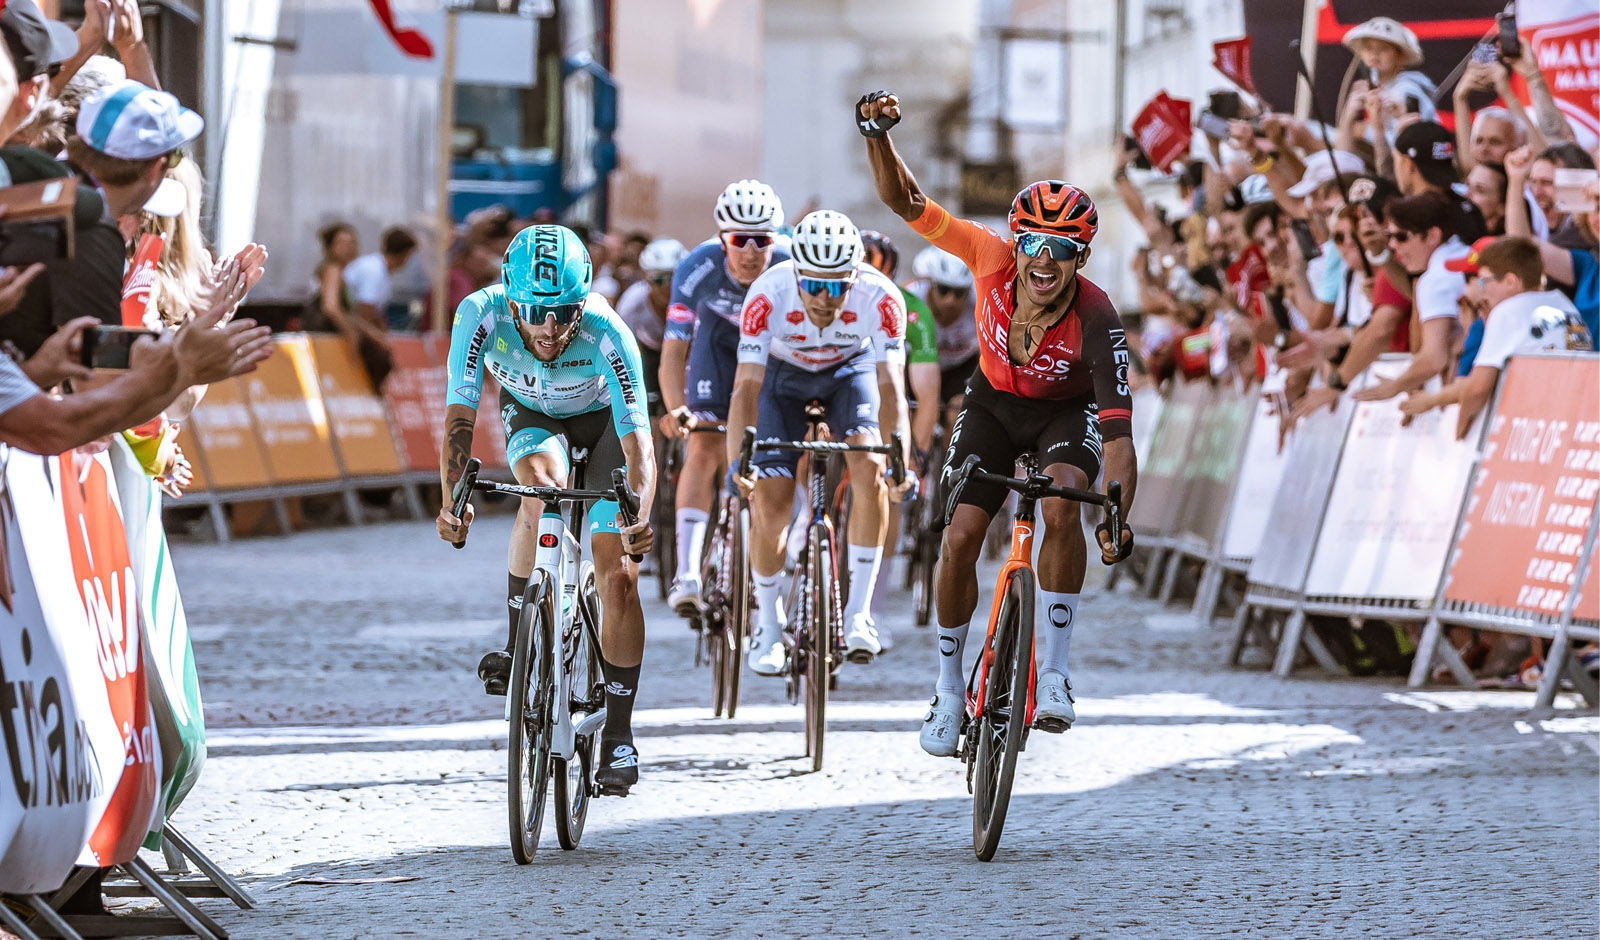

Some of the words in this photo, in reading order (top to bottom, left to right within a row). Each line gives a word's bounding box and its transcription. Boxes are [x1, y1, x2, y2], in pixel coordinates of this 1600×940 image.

[466, 323, 489, 370] FAIZANE
[541, 361, 559, 370] DE
[561, 358, 593, 369] ROSA
[1108, 327, 1131, 397] INEOS
[610, 356, 636, 405] FAIZANE
[512, 433, 534, 448] FTC
